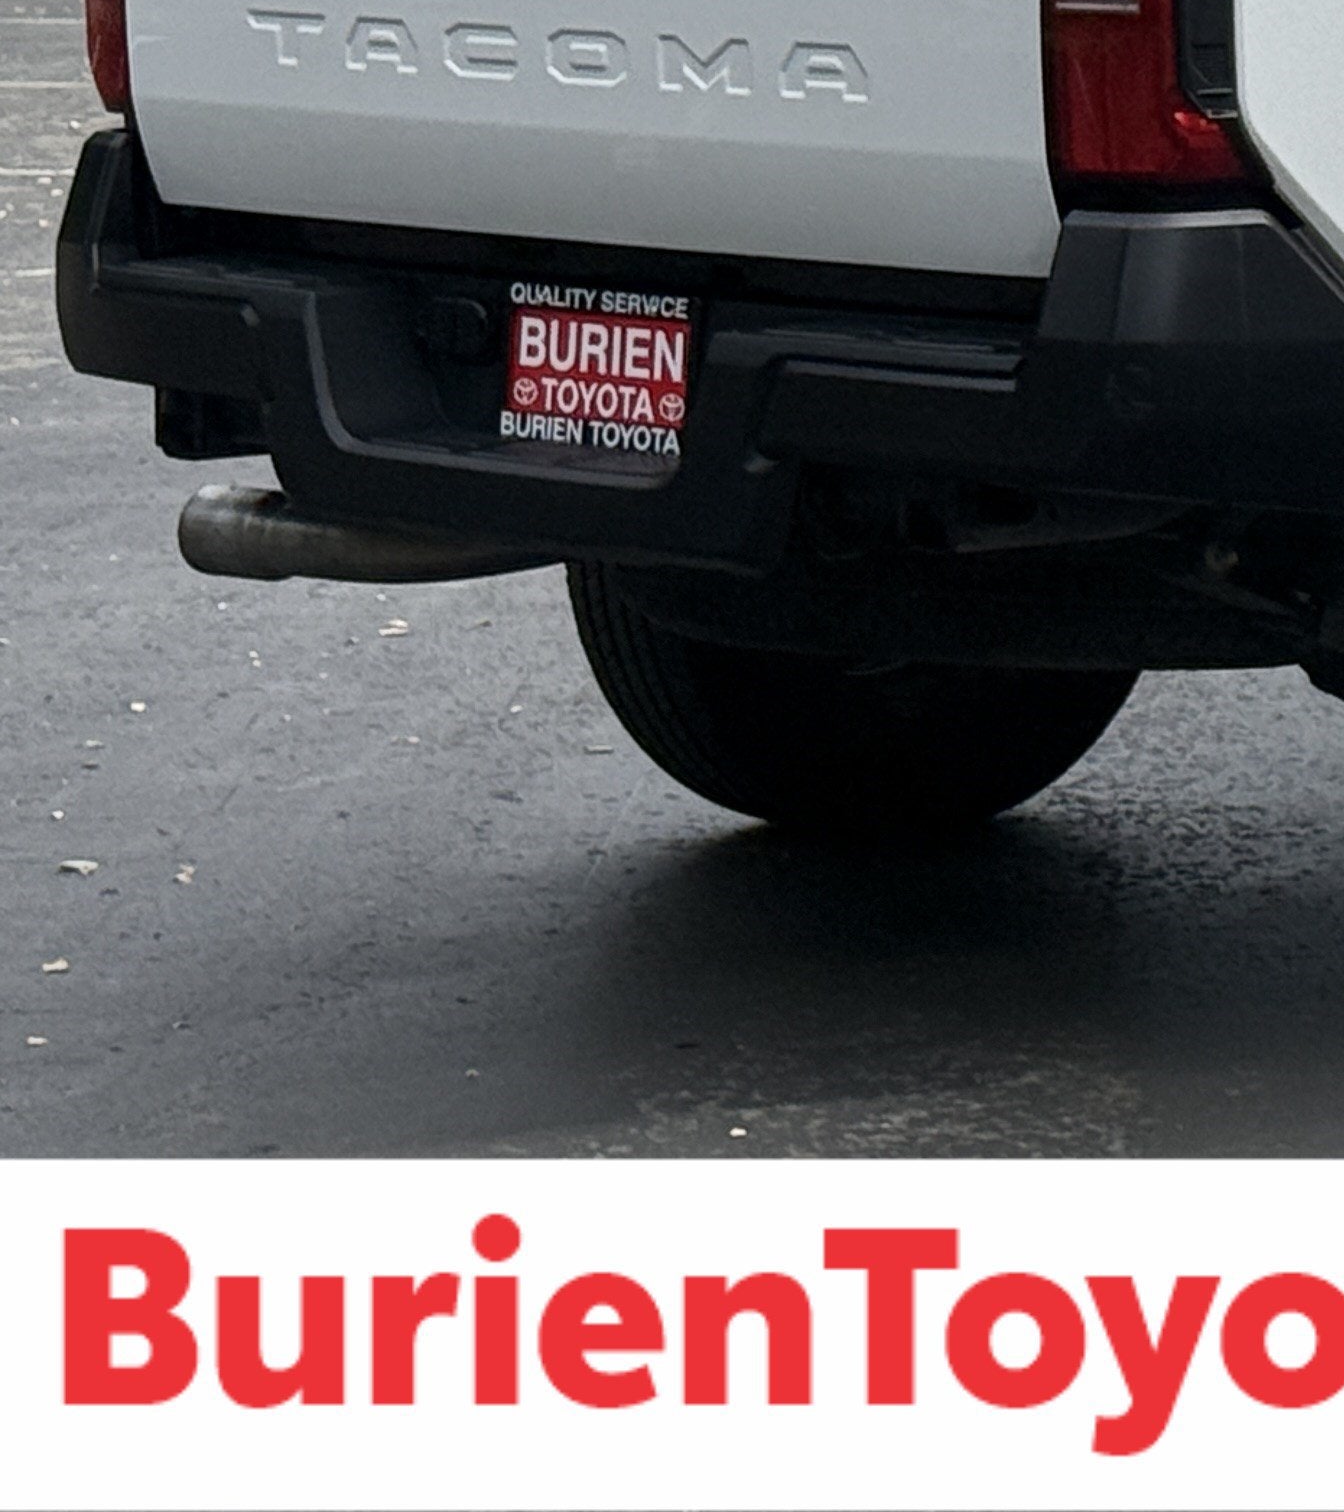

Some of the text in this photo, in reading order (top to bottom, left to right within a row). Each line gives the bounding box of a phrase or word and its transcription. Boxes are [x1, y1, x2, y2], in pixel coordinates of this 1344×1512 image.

[245, 7, 869, 103] TACOMA
[510, 282, 689, 320] QUALITY SERVICE
[519, 316, 684, 383] BURIEN
[541, 376, 655, 424] TOYOTA
[500, 410, 681, 456] BURIEN TOYOTA
